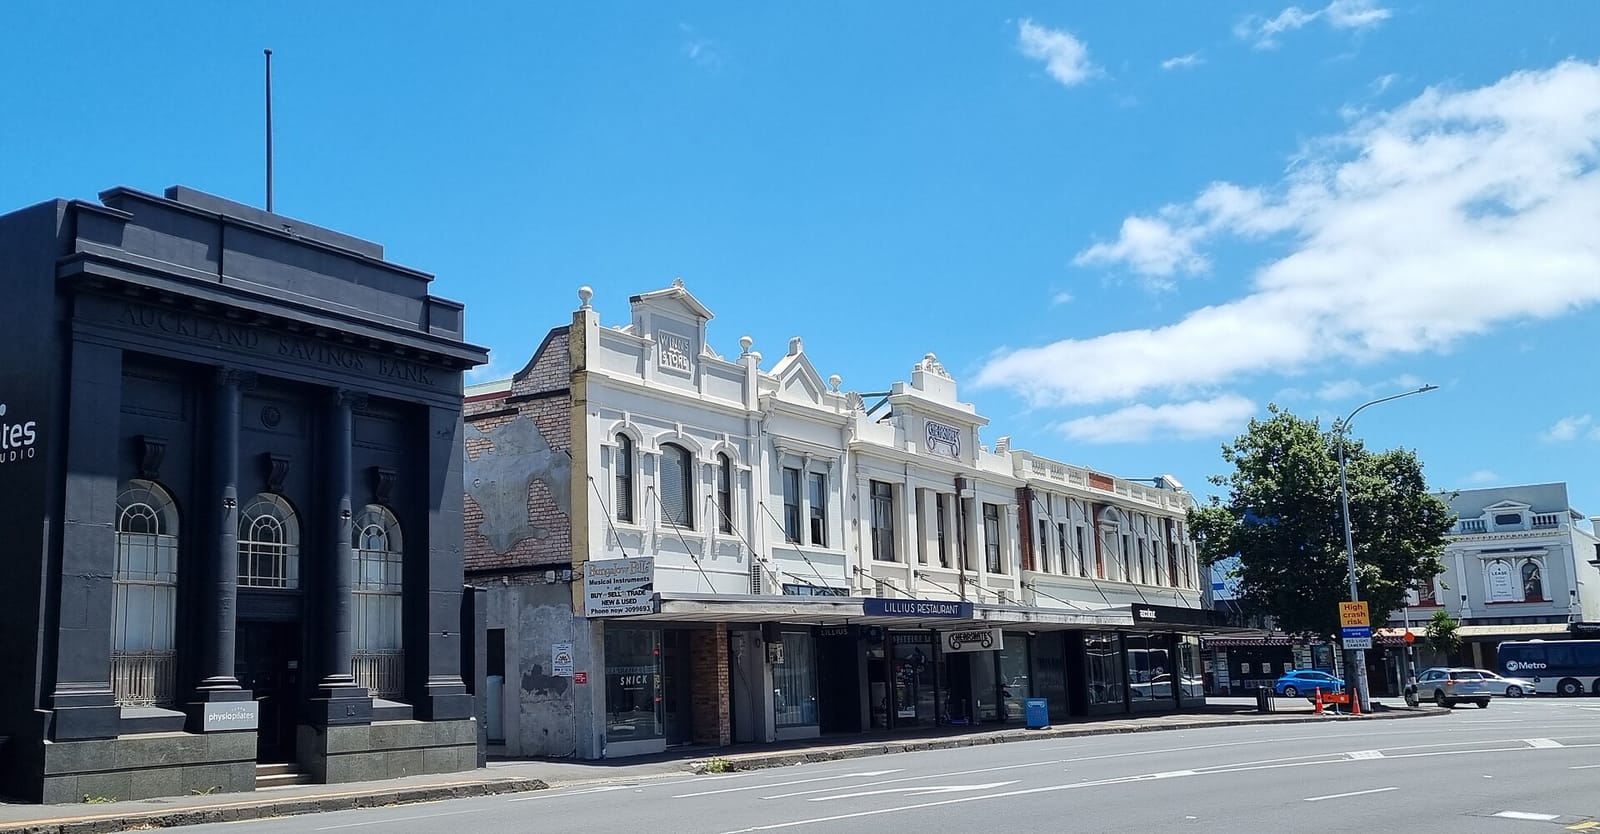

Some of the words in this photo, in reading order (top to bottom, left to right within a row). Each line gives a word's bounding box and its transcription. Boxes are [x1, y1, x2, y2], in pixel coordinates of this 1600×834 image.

[118, 301, 258, 349] AUCKLAND
[278, 338, 365, 369] SAVINGS
[662, 351, 689, 369] STORE
[613, 576, 650, 584] Instruments
[627, 589, 647, 597] TRADE
[884, 602, 915, 613] LILLIUS
[917, 603, 959, 615] RESTAURANT
[1343, 603, 1363, 611] High
[821, 628, 848, 637] LILLIUS
